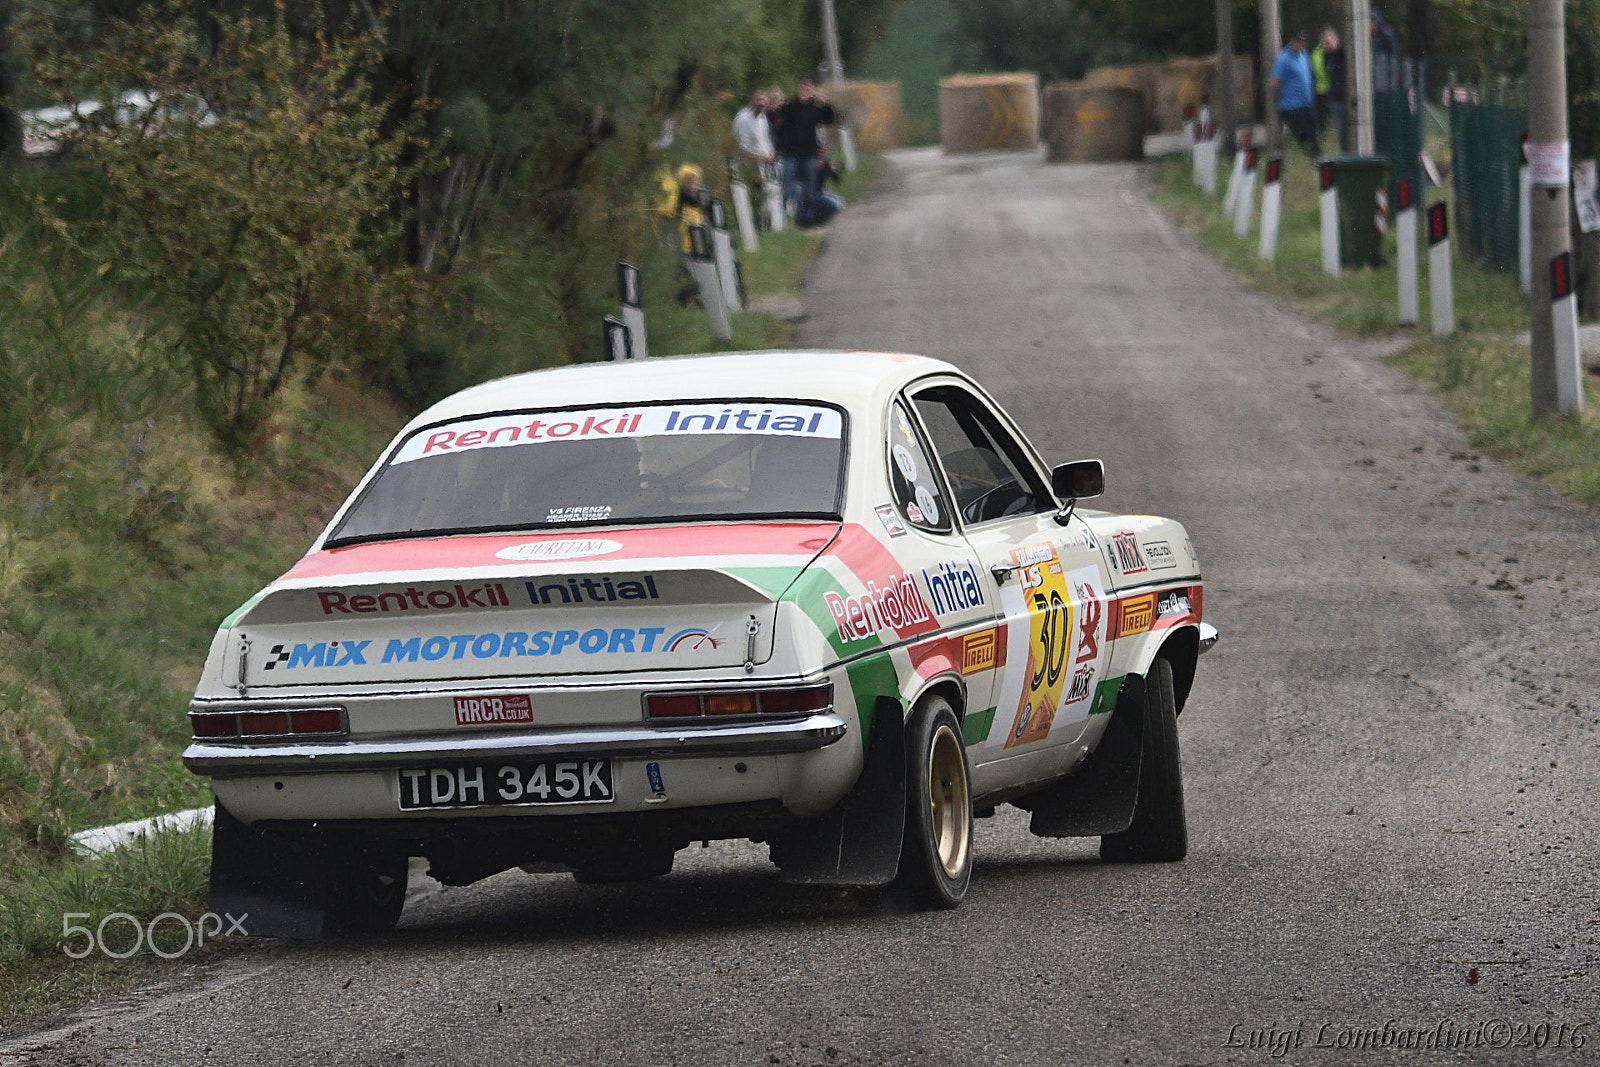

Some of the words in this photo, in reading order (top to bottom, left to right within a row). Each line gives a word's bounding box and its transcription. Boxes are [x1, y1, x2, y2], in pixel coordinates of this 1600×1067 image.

[422, 413, 643, 455] Rentokil
[664, 409, 823, 434] Initial
[565, 505, 612, 514] FIRENZA
[518, 541, 604, 555] LAURETANA
[317, 583, 510, 614] Rentokil
[524, 575, 660, 605] Initial
[1020, 566, 1043, 589] LS
[823, 572, 930, 644] Rentokil
[922, 559, 985, 616] Initial
[1121, 601, 1152, 632] PIRELLI
[381, 627, 665, 663] MOTORSPORT
[963, 632, 994, 668] PIRELLI
[1031, 590, 1068, 691] 30
[457, 698, 505, 722] HRCR
[402, 767, 485, 804] TDH
[498, 761, 610, 800] 345K
